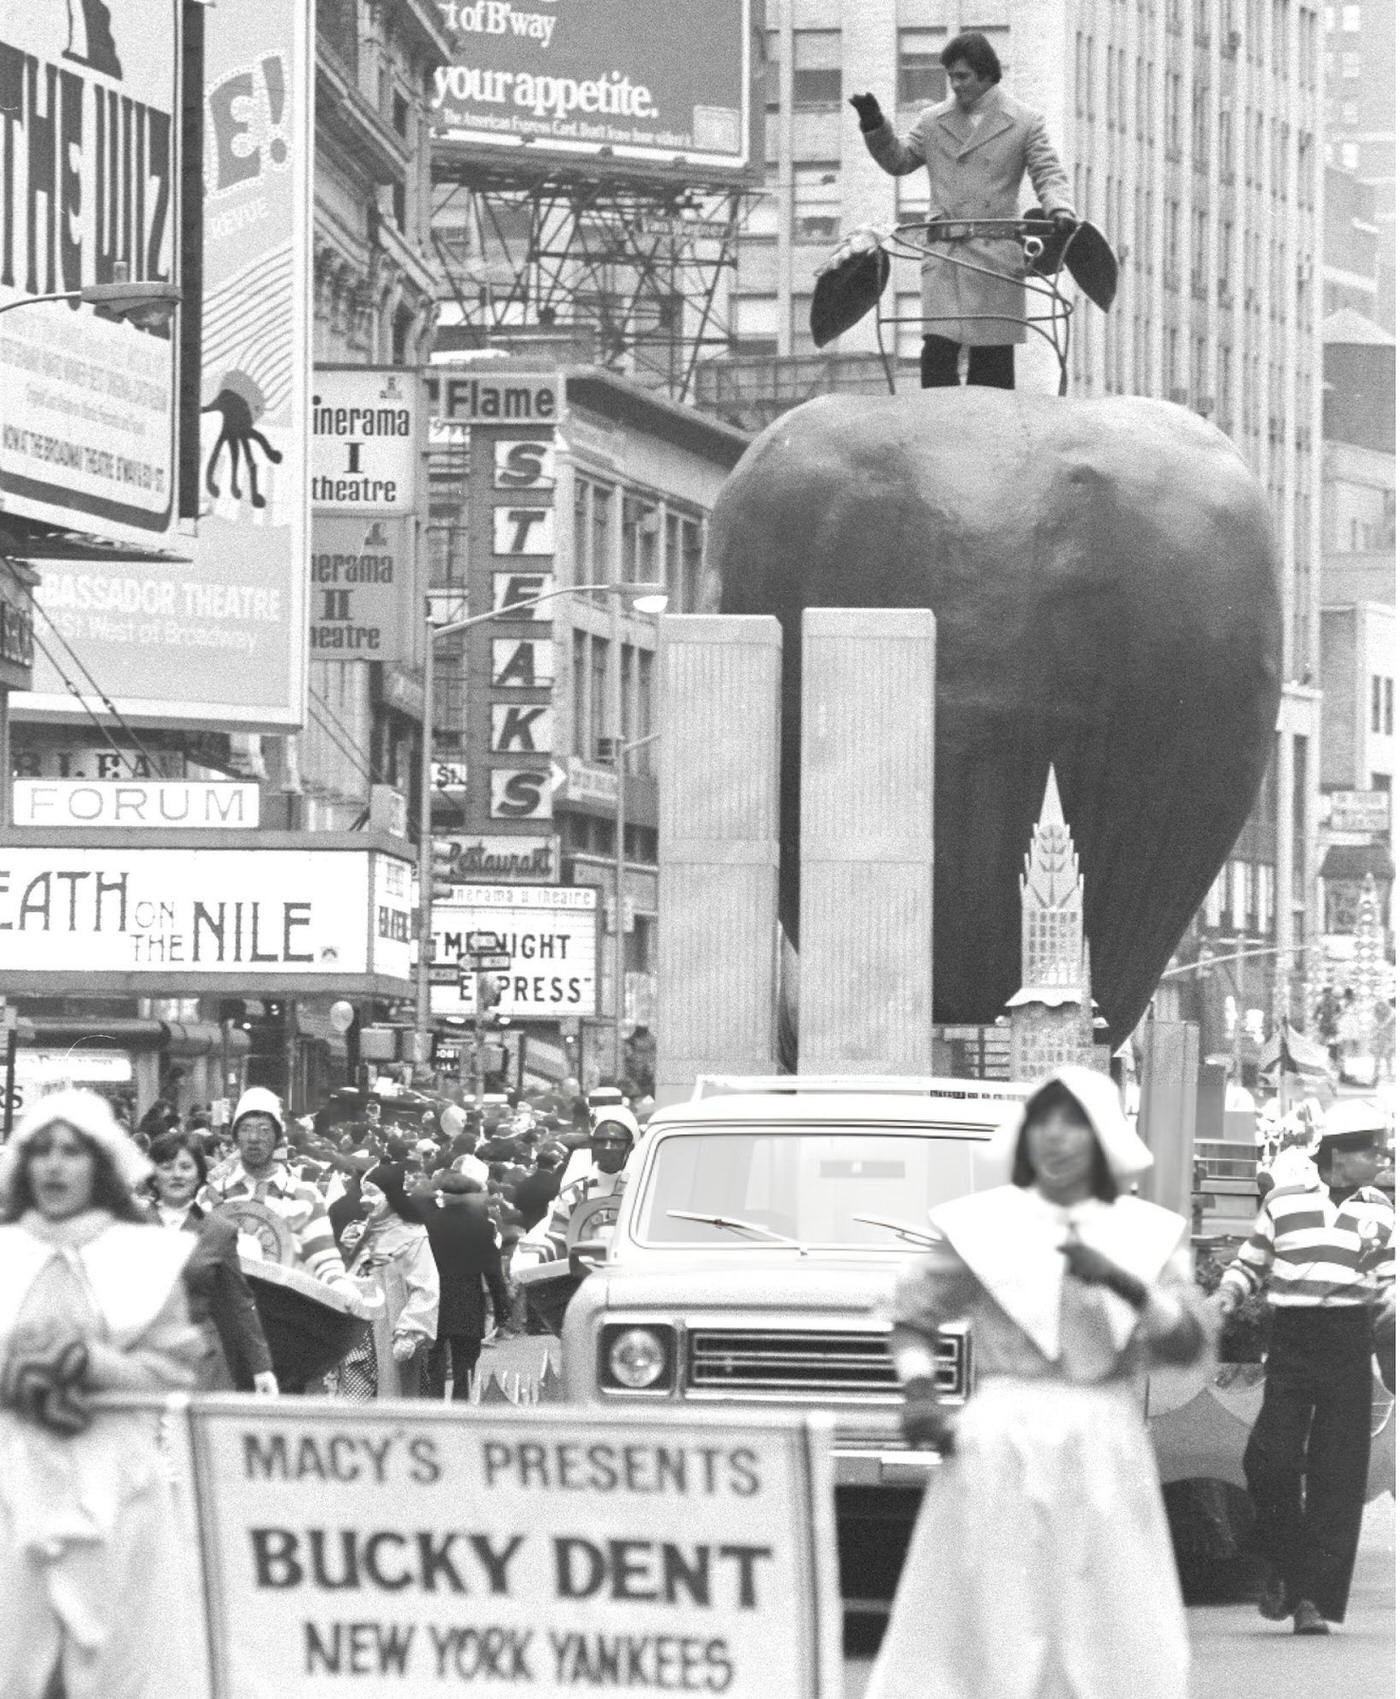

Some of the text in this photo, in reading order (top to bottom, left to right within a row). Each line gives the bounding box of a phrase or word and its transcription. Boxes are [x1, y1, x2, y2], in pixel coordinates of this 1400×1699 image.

[431, 66, 660, 118] your appetite.
[446, 379, 554, 418] Flame
[343, 441, 365, 474] I
[311, 476, 396, 502] theatre
[181, 582, 282, 622] THEATRE
[319, 588, 354, 621] II
[496, 442, 548, 817] STEAKS
[30, 787, 244, 821] FORUM
[135, 901, 175, 928] ON
[192, 901, 315, 962] NILE
[130, 934, 185, 962] THE
[241, 1431, 762, 1497] MACY'S PRESENTS
[249, 1527, 774, 1610] BUCKY DENT
[303, 1620, 736, 1695] NEW YORK YANKEES
